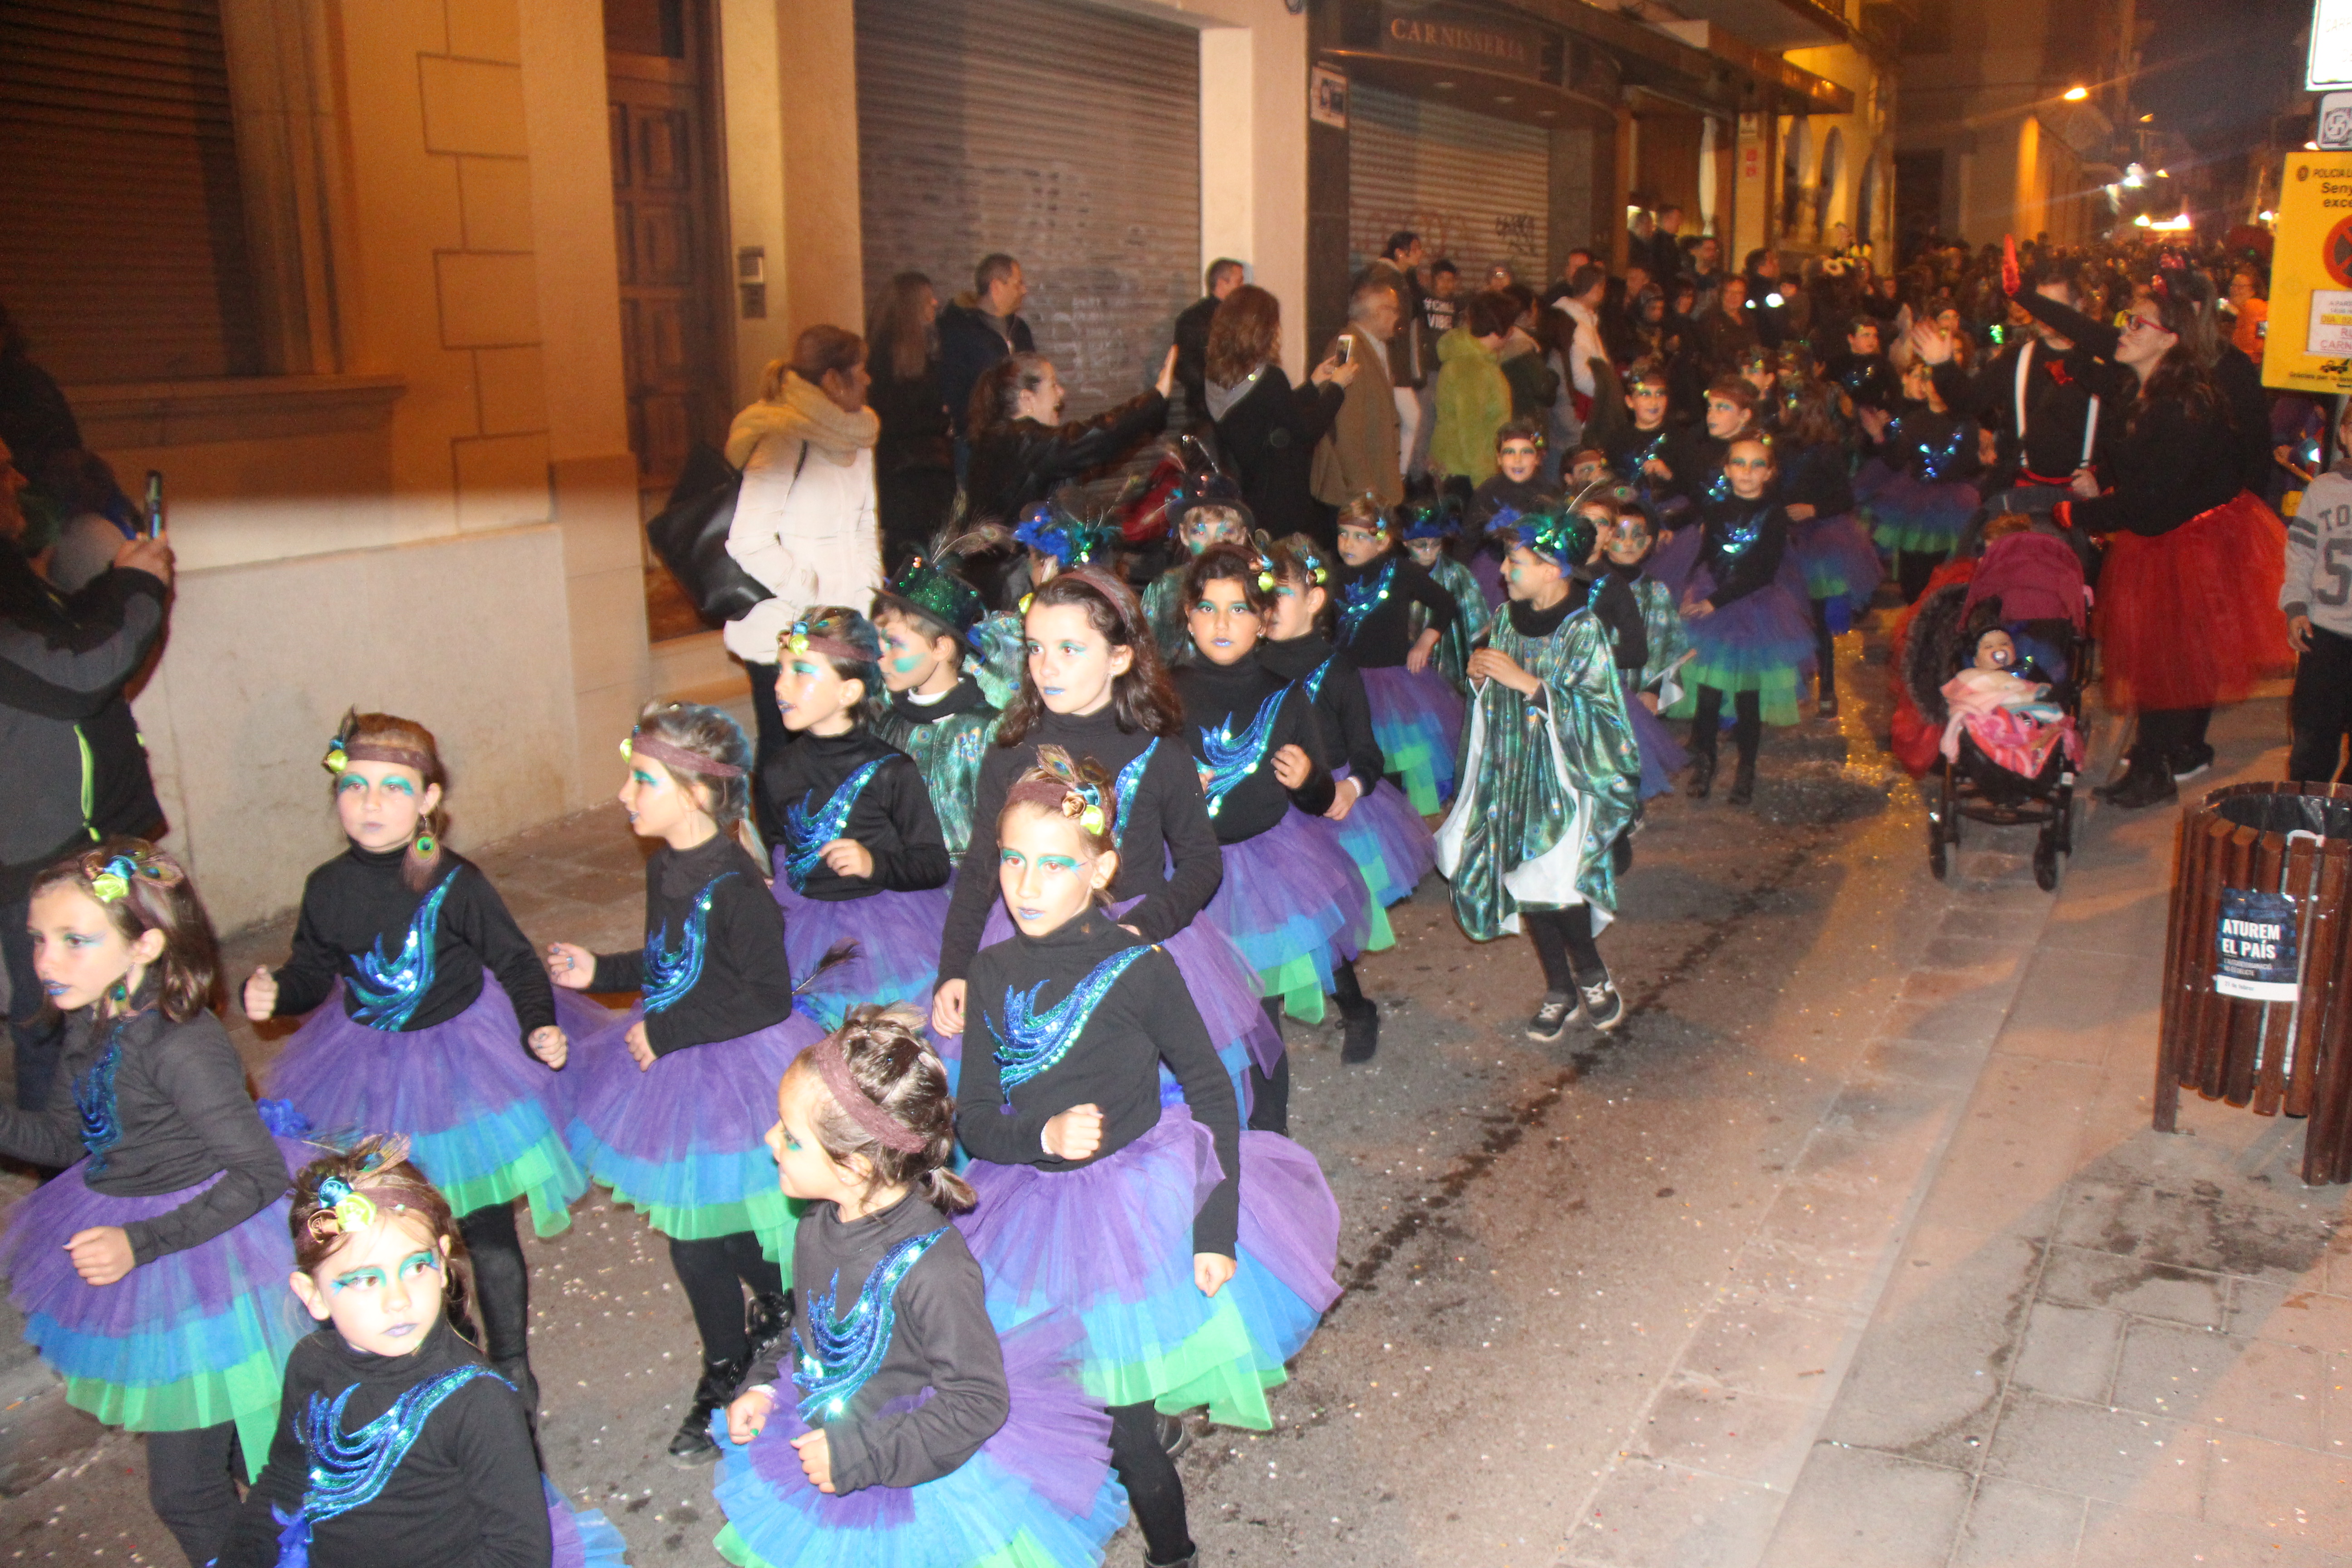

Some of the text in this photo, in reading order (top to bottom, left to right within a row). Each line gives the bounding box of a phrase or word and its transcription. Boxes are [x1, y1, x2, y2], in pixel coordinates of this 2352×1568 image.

[1391, 18, 1524, 60] CARNISSERIA
[2222, 918, 2282, 940] ATUREM
[2222, 938, 2277, 959] EL PAÍS
